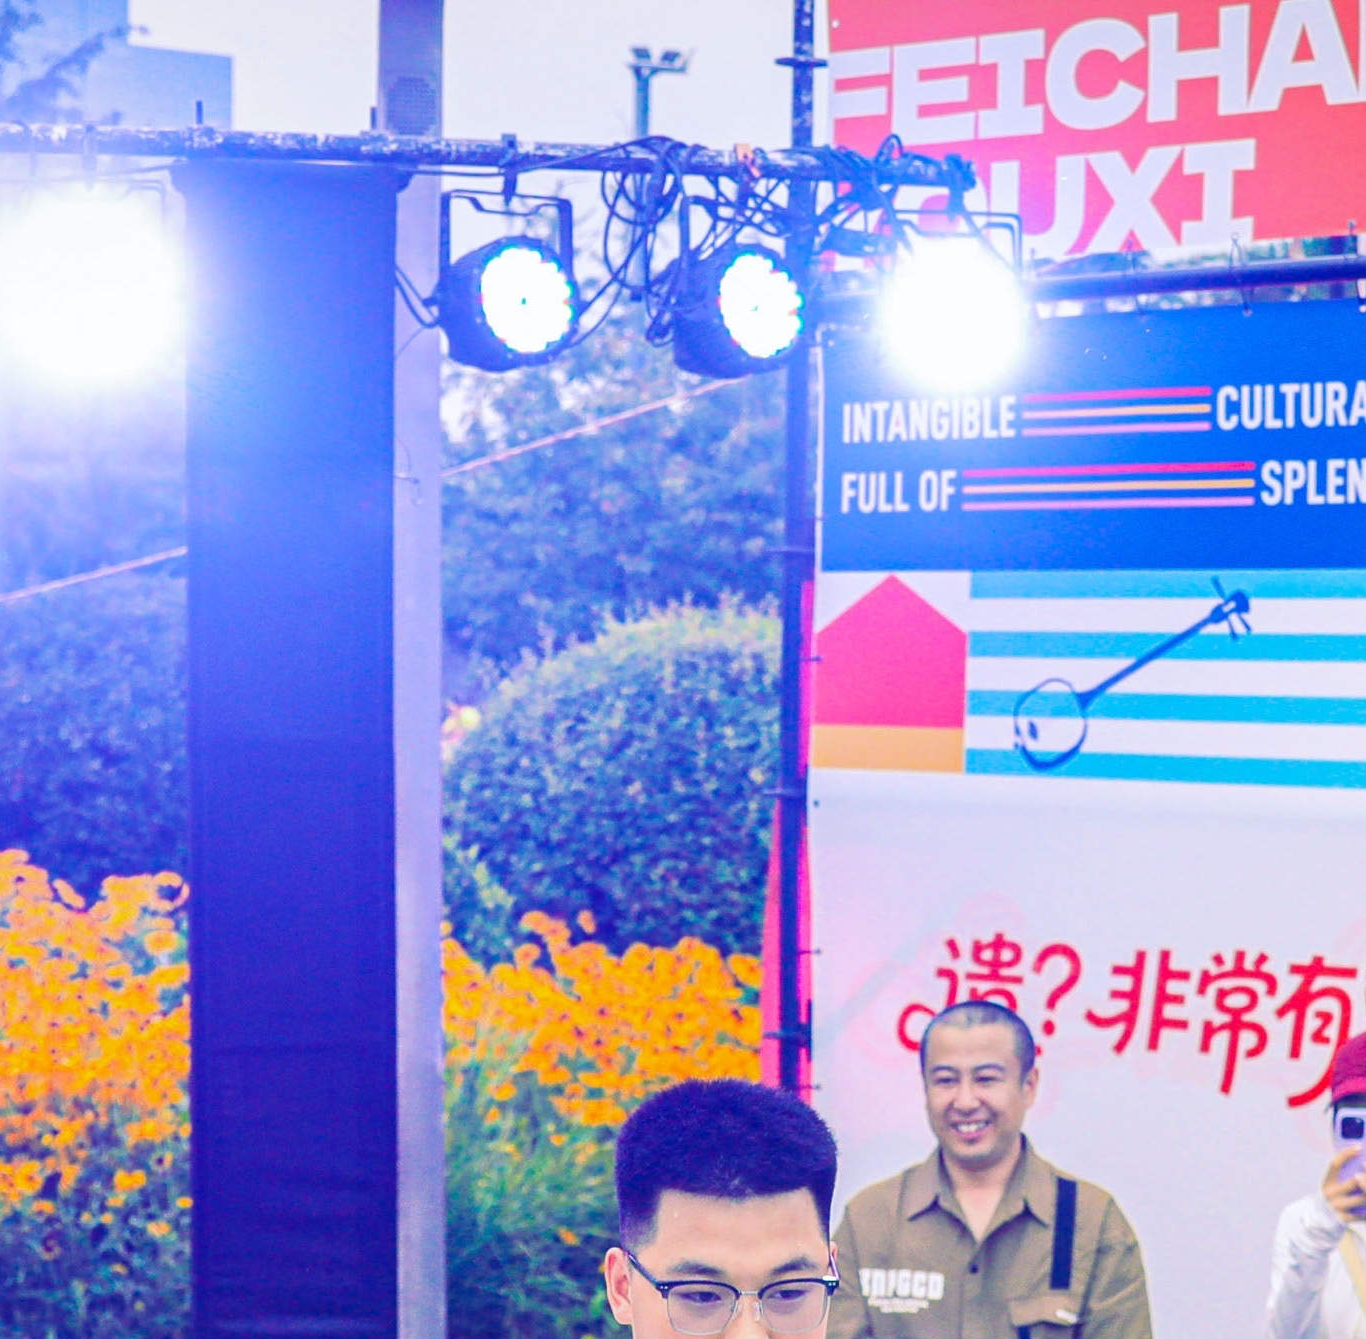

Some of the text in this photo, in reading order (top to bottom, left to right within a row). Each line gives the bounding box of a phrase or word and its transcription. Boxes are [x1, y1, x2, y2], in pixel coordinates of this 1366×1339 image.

[841, 396, 1018, 444] INTANGIBLE
[840, 470, 911, 513] FULL
[918, 468, 957, 511] OF
